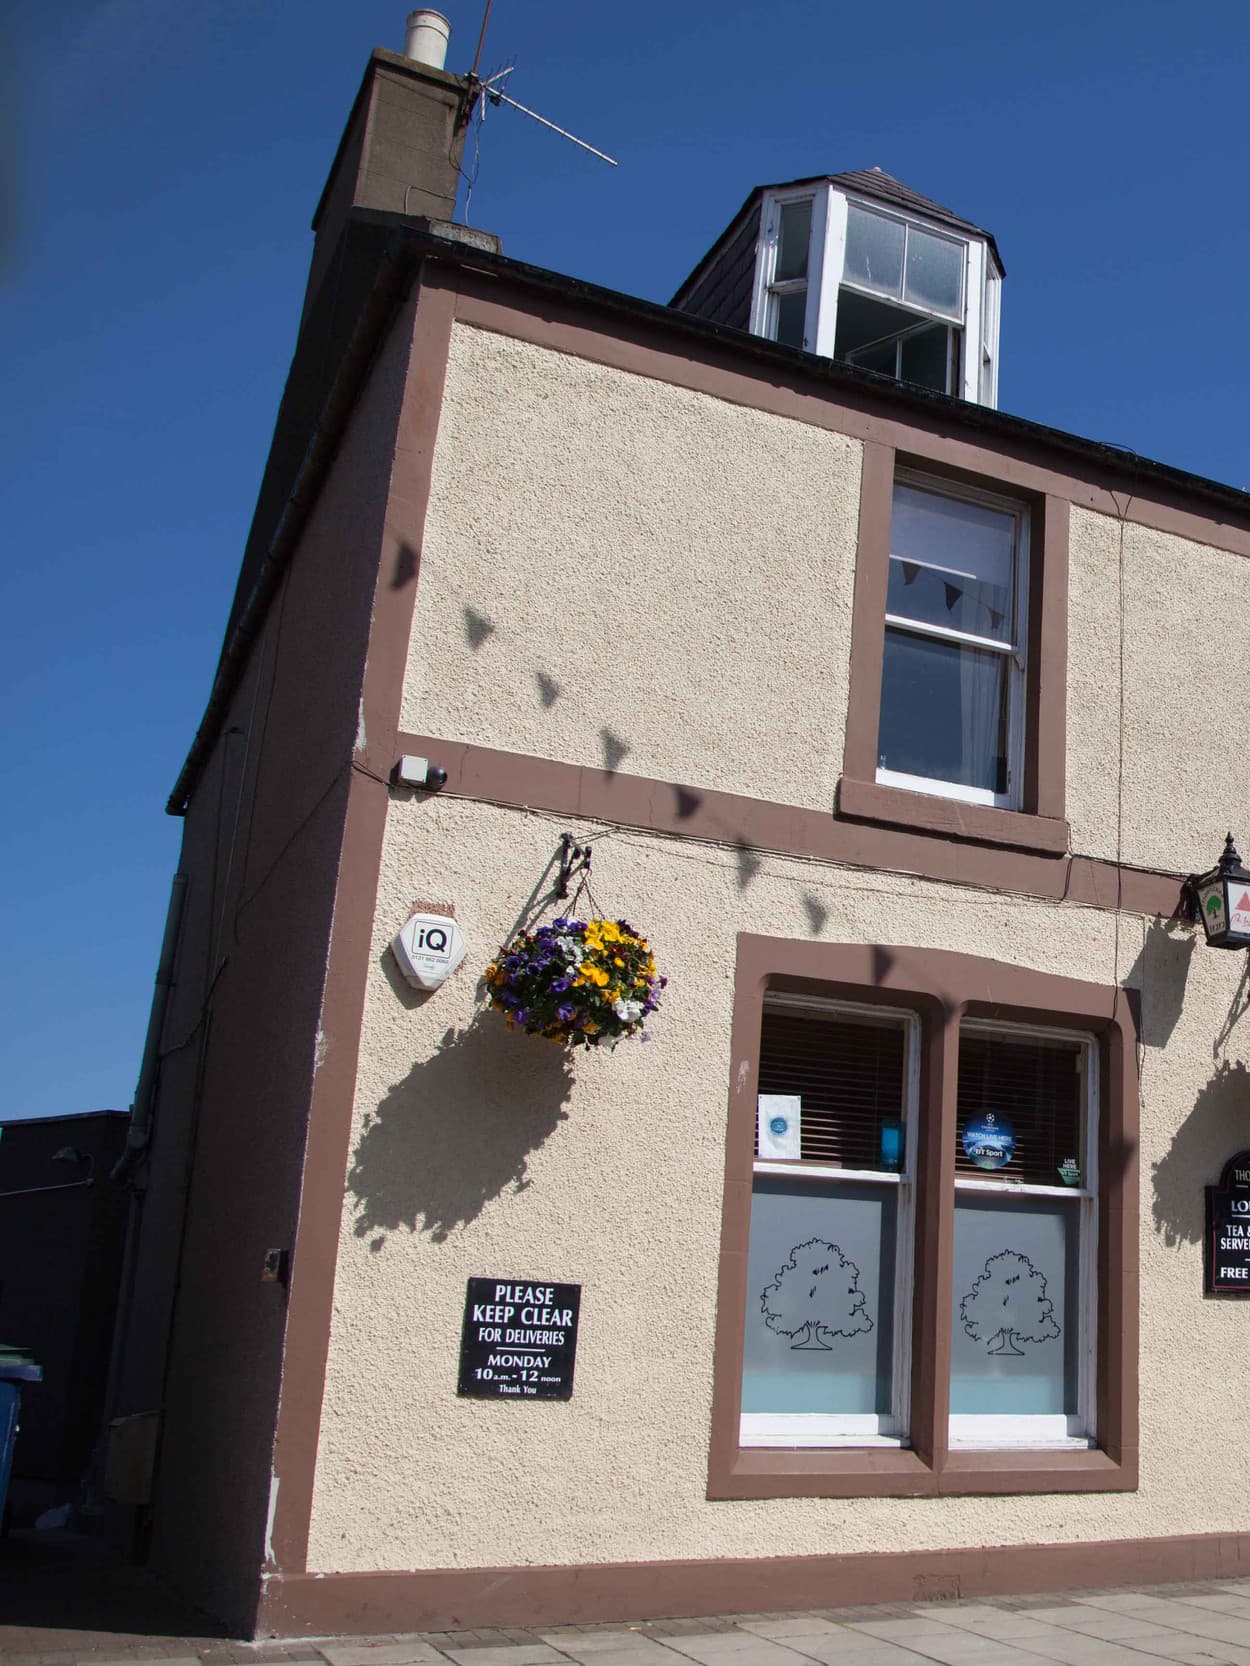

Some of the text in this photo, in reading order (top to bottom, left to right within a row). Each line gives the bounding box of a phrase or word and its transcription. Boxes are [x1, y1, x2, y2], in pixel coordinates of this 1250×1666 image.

[418, 928, 447, 953] iQ
[1226, 1225, 1244, 1237] TEA
[1220, 1267, 1249, 1279] FREE
[495, 1284, 554, 1305] PLEASE
[473, 1304, 573, 1326] KEEP CLEAR
[478, 1327, 565, 1345] FOR DELIVERIES
[487, 1354, 552, 1368] MONDAY
[520, 1370, 538, 1382] 12
[499, 1384, 537, 1394] Thank You
